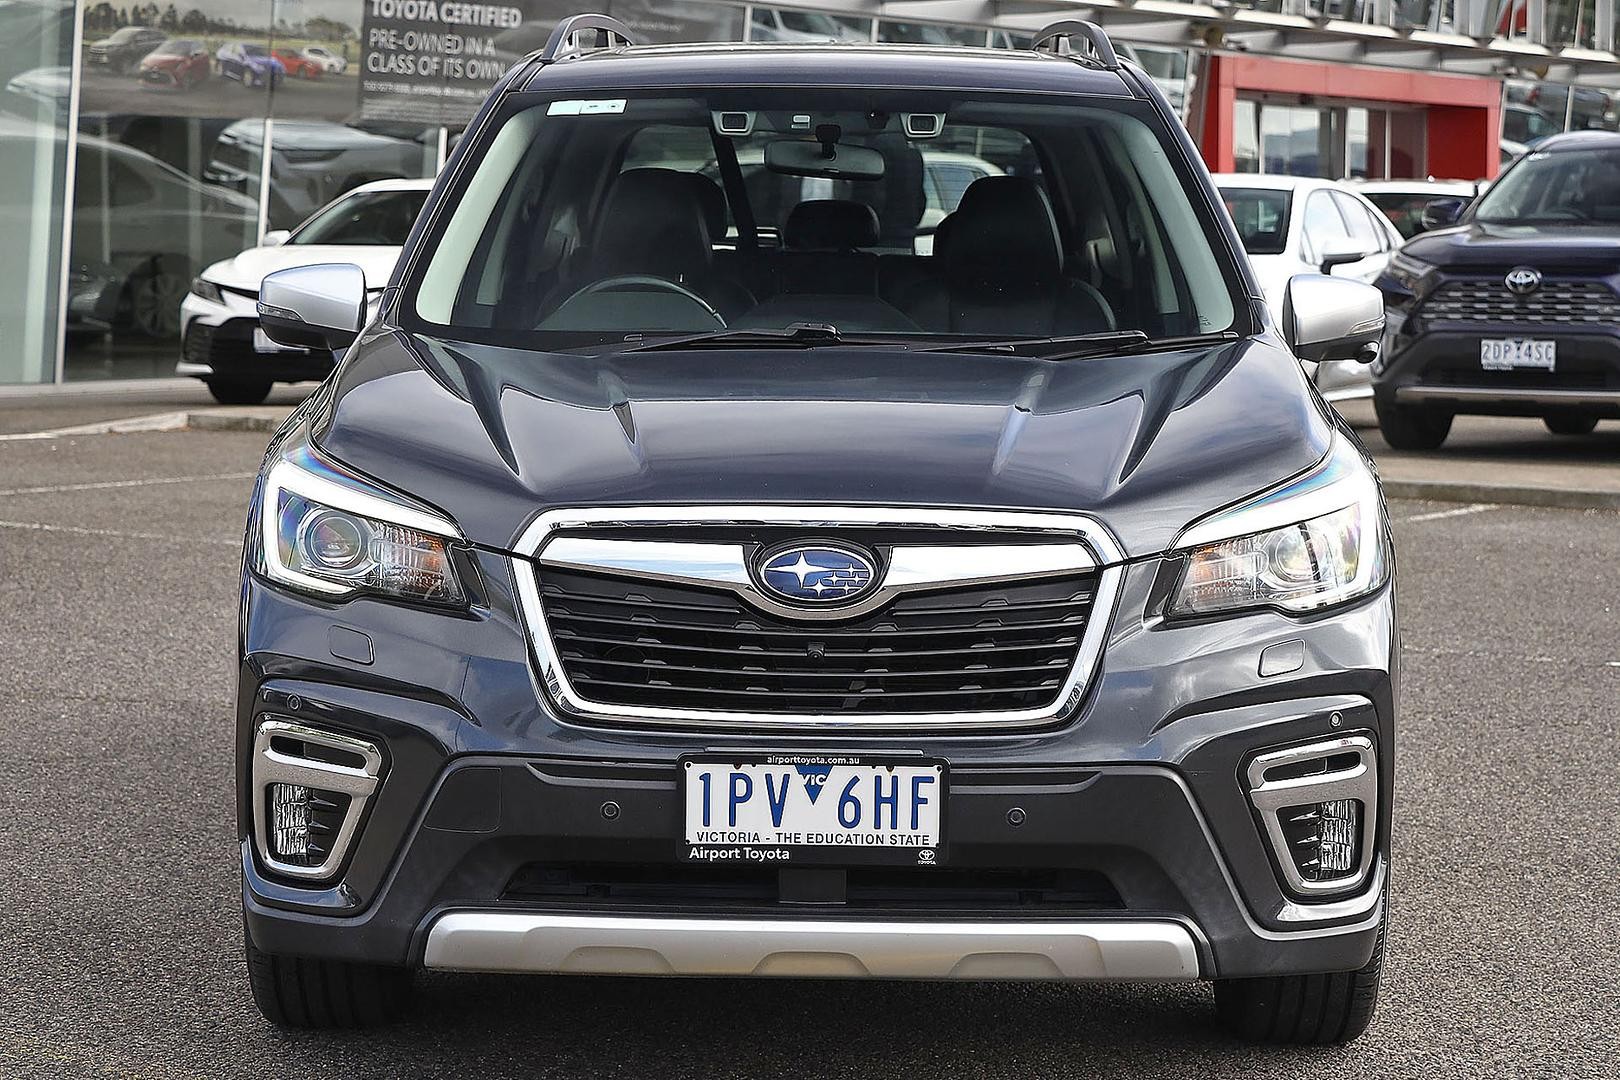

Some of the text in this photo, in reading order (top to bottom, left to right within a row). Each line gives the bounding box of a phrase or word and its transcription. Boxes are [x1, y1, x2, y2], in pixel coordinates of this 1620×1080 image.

[372, 0, 522, 28] TOYOTA CERTIFIED
[369, 28, 496, 56] PRE-OWNED IN A
[367, 52, 416, 75] CLASS
[417, 55, 441, 77] OF
[442, 57, 464, 79] ITS
[767, 755, 860, 765] airporttoyota.com.au
[699, 773, 936, 830] 1PV 6HF
[697, 831, 761, 843] VICTORIA
[776, 832, 802, 844] THE
[806, 833, 884, 845] EDUCATION
[889, 834, 930, 846] STATE
[689, 847, 790, 861] Airport Toyota
